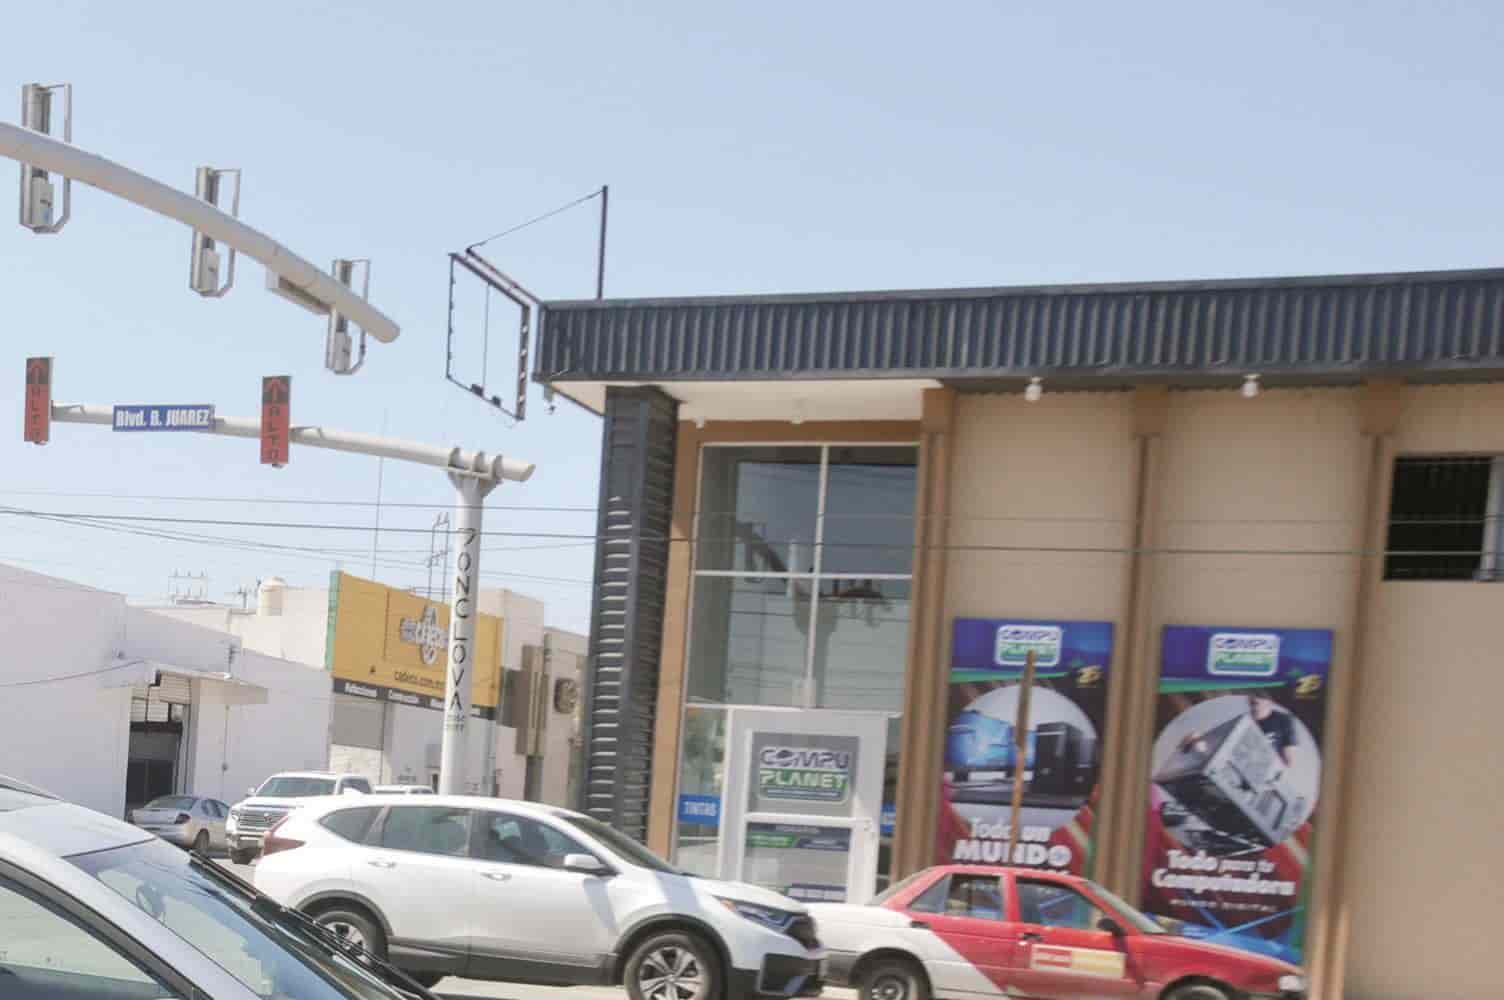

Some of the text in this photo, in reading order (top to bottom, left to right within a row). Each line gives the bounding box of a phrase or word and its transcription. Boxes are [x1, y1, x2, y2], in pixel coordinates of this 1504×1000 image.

[760, 748, 848, 769] COMPU
[759, 770, 847, 789] PLANET
[953, 839, 1073, 867] MUNDO
[1167, 848, 1218, 871] Todo
